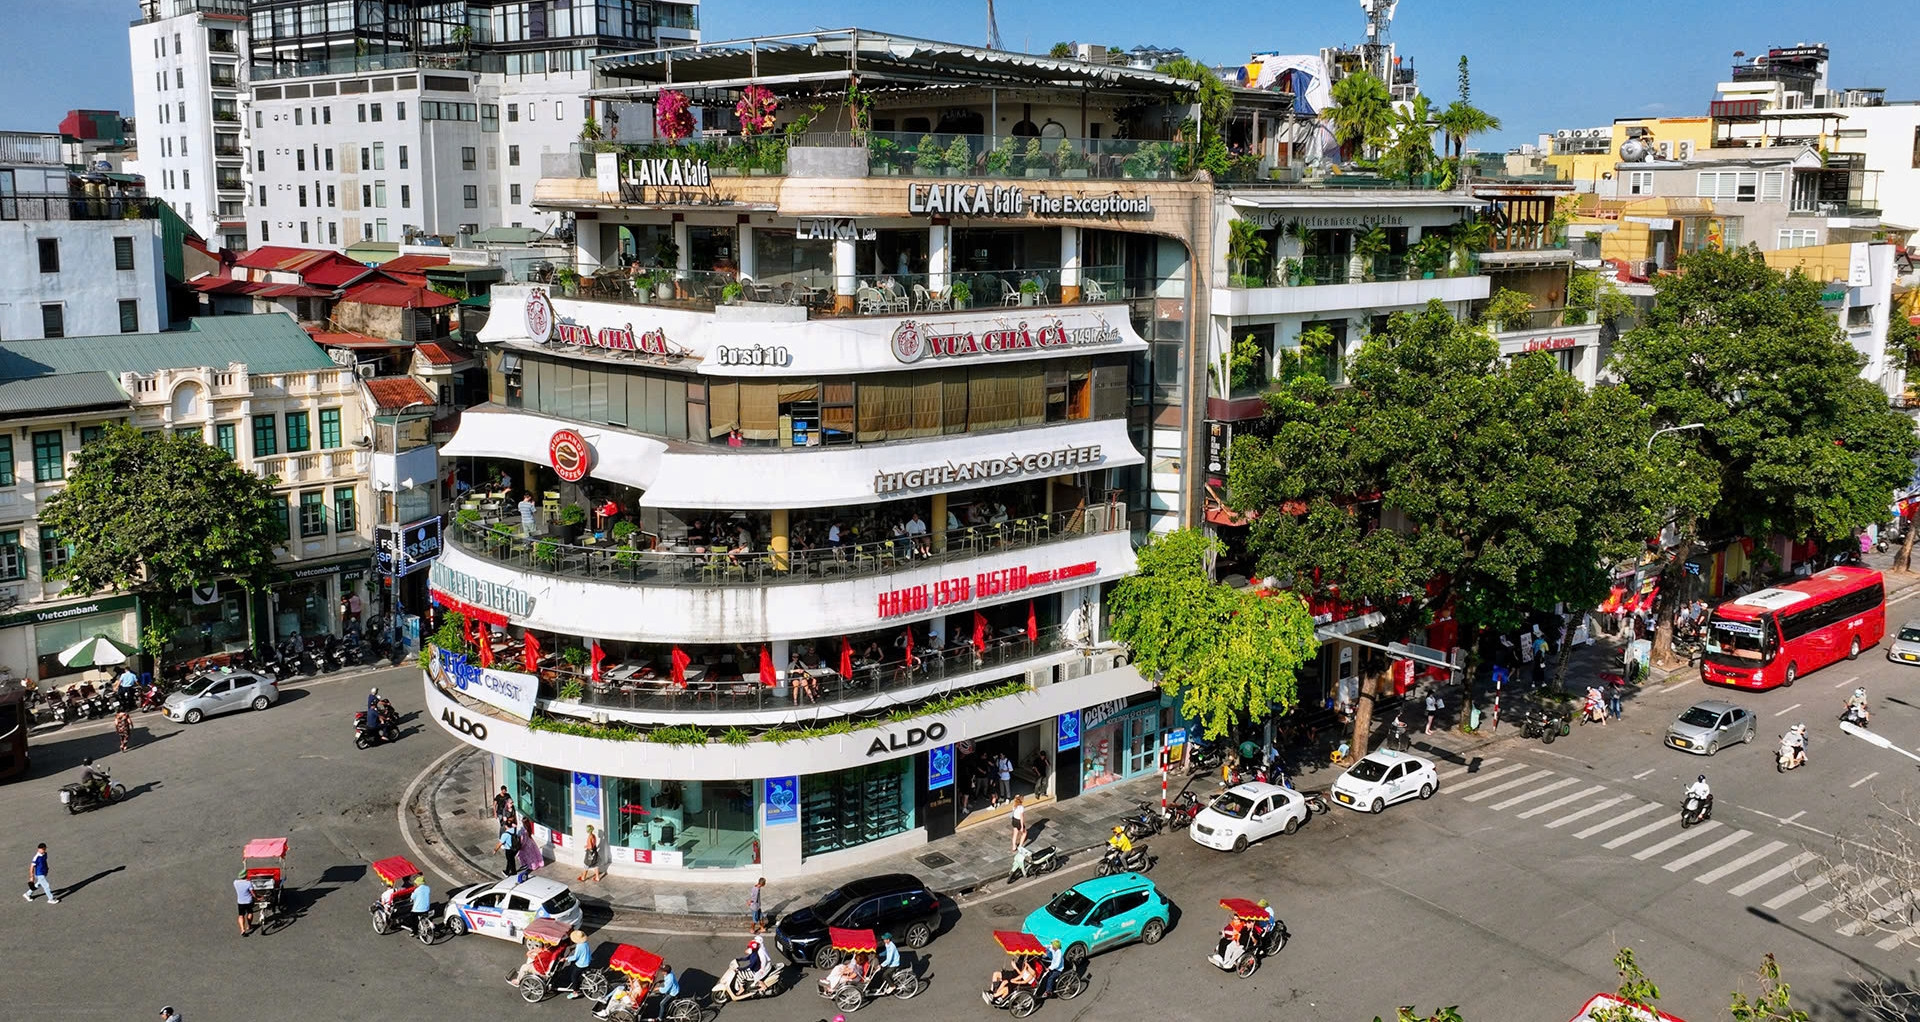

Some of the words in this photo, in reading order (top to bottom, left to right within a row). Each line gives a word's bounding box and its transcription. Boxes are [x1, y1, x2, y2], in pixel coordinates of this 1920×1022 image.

[628, 158, 683, 186] LAIKA
[684, 158, 710, 186] Café
[909, 183, 990, 213] LAIKA
[993, 185, 1024, 213] Café
[1029, 195, 1061, 213] The
[1063, 195, 1151, 216] Exceptional
[796, 218, 859, 240] LAIKA
[862, 227, 877, 241] Café
[558, 324, 593, 347] VUA
[927, 334, 978, 356] VUA
[765, 346, 788, 366] 10
[551, 433, 584, 457] HIGHLANDS
[555, 464, 582, 479] COFFEE
[875, 459, 1019, 493] HIGHLANDS
[1023, 445, 1101, 471] COFFEE
[379, 552, 392, 563] SP
[295, 565, 340, 577] Vietcombank
[344, 572, 360, 580] ATM
[481, 580, 528, 617] BISTRO
[878, 584, 927, 618] HANOI
[976, 565, 1028, 598] BISTRO
[37, 604, 99, 621] Vietcombank
[440, 648, 483, 691] Tiger
[441, 707, 487, 740] ALDO
[866, 722, 948, 757] ALDO
